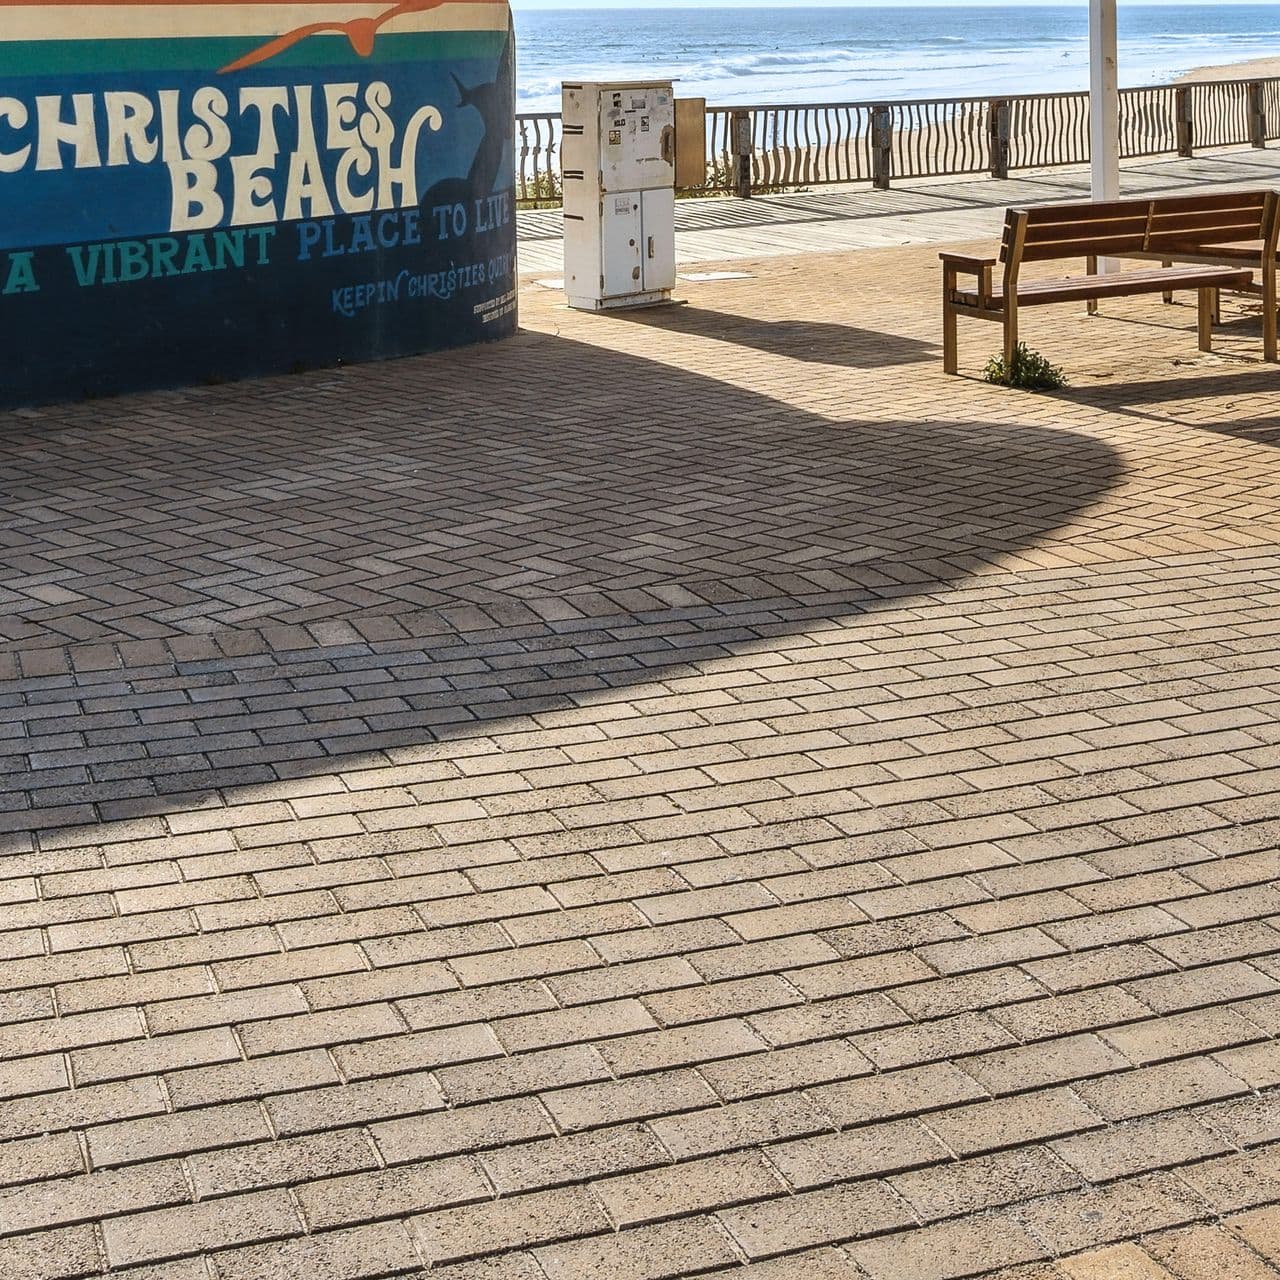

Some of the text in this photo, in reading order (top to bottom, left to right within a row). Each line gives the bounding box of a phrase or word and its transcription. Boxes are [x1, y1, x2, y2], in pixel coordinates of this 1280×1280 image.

[167, 105, 442, 232] BEACH
[1, 191, 510, 296] A VIBRANT PLACE TO LIVE
[408, 263, 485, 300] CHRISTIES
